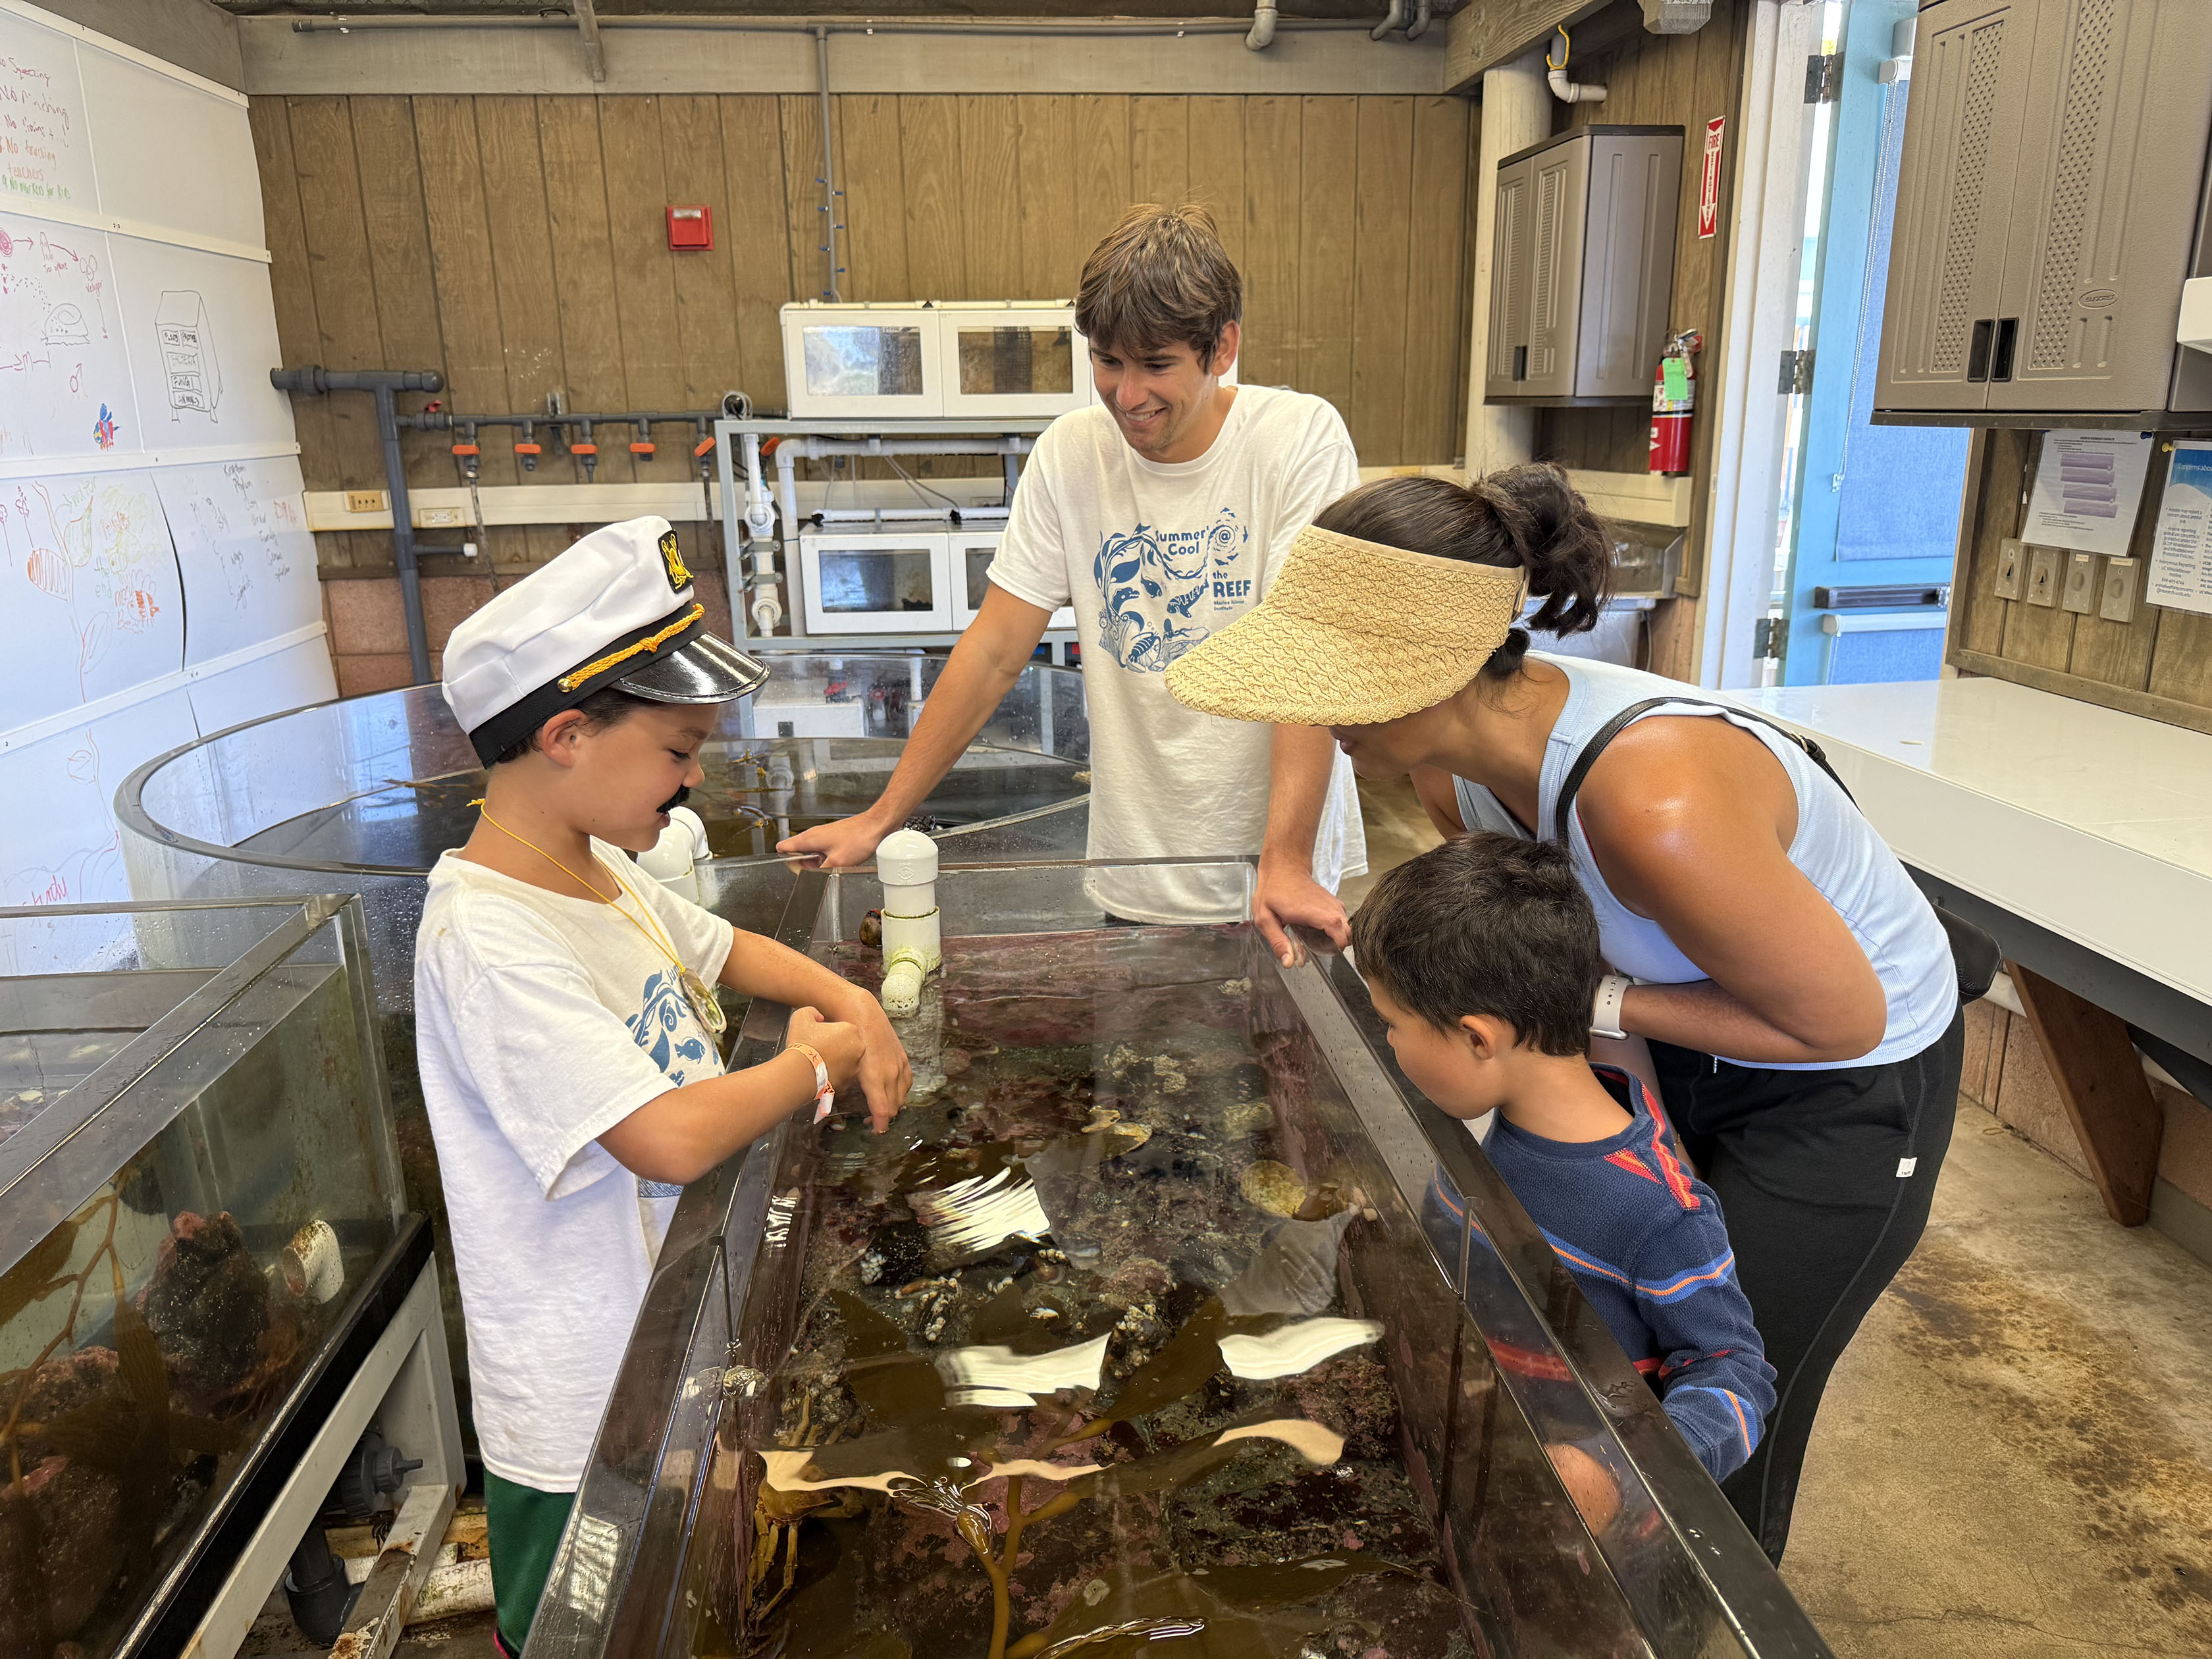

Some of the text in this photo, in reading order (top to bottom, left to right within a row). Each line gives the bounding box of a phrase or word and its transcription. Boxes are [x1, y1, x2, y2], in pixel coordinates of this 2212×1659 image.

[5, 136, 18, 153] No
[1708, 133, 1720, 150] FIRE
[1168, 541, 1199, 556] Cool
[1213, 571, 1228, 579] the
[1213, 580, 1251, 598] REEF
